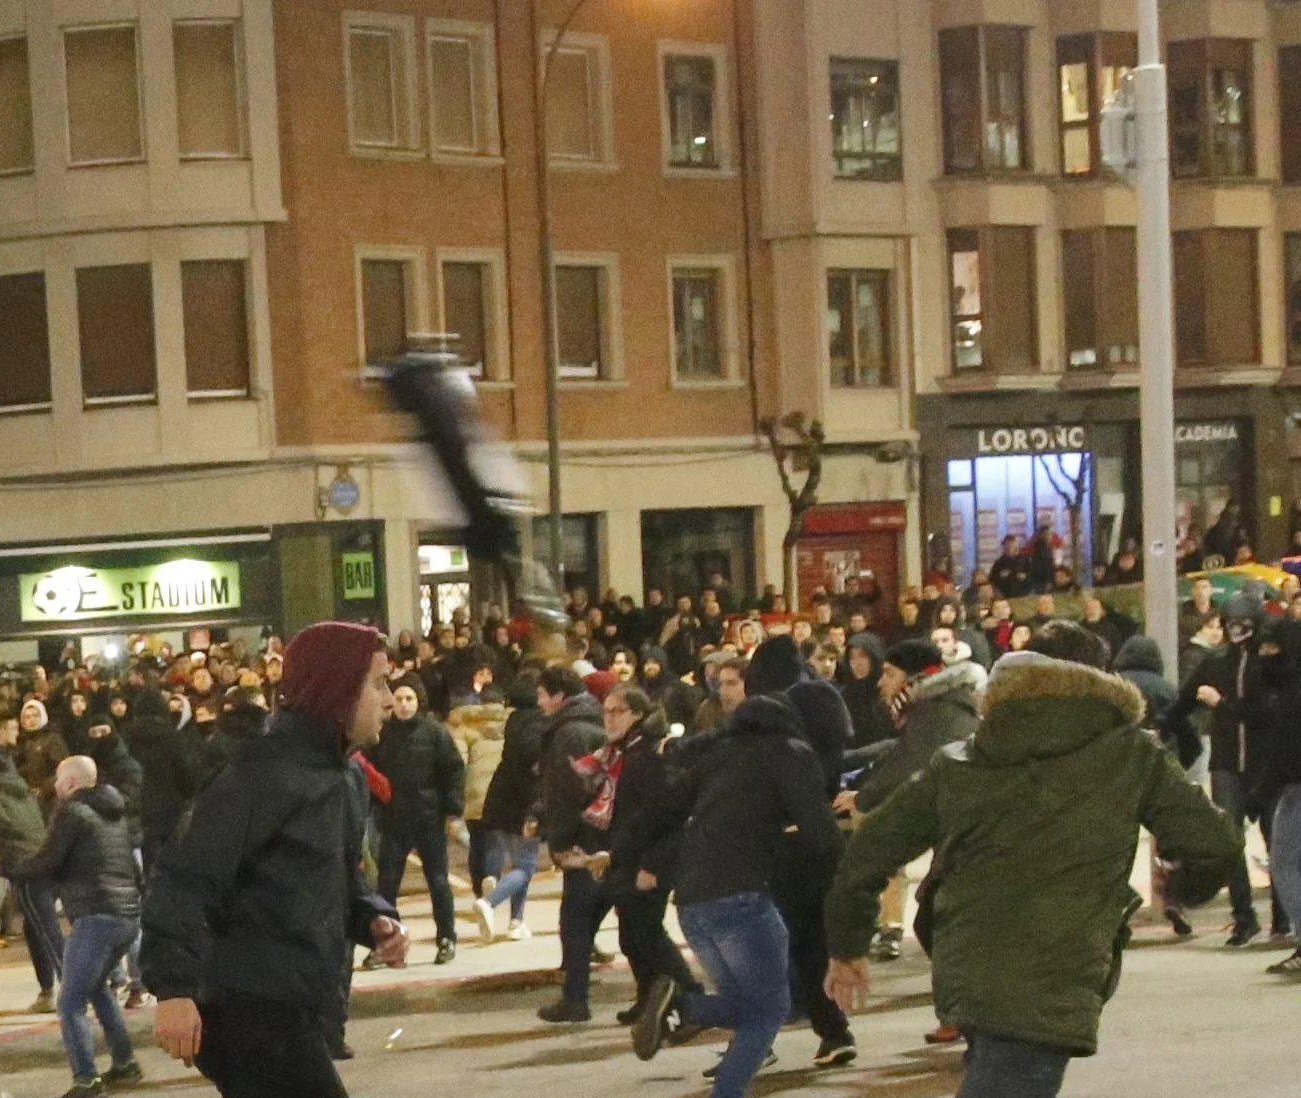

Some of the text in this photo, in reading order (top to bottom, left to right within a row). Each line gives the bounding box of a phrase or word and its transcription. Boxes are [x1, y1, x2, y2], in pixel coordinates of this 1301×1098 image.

[1174, 424, 1239, 443] CADEMIA
[346, 561, 372, 590] BAR
[121, 575, 230, 611] STADIUM
